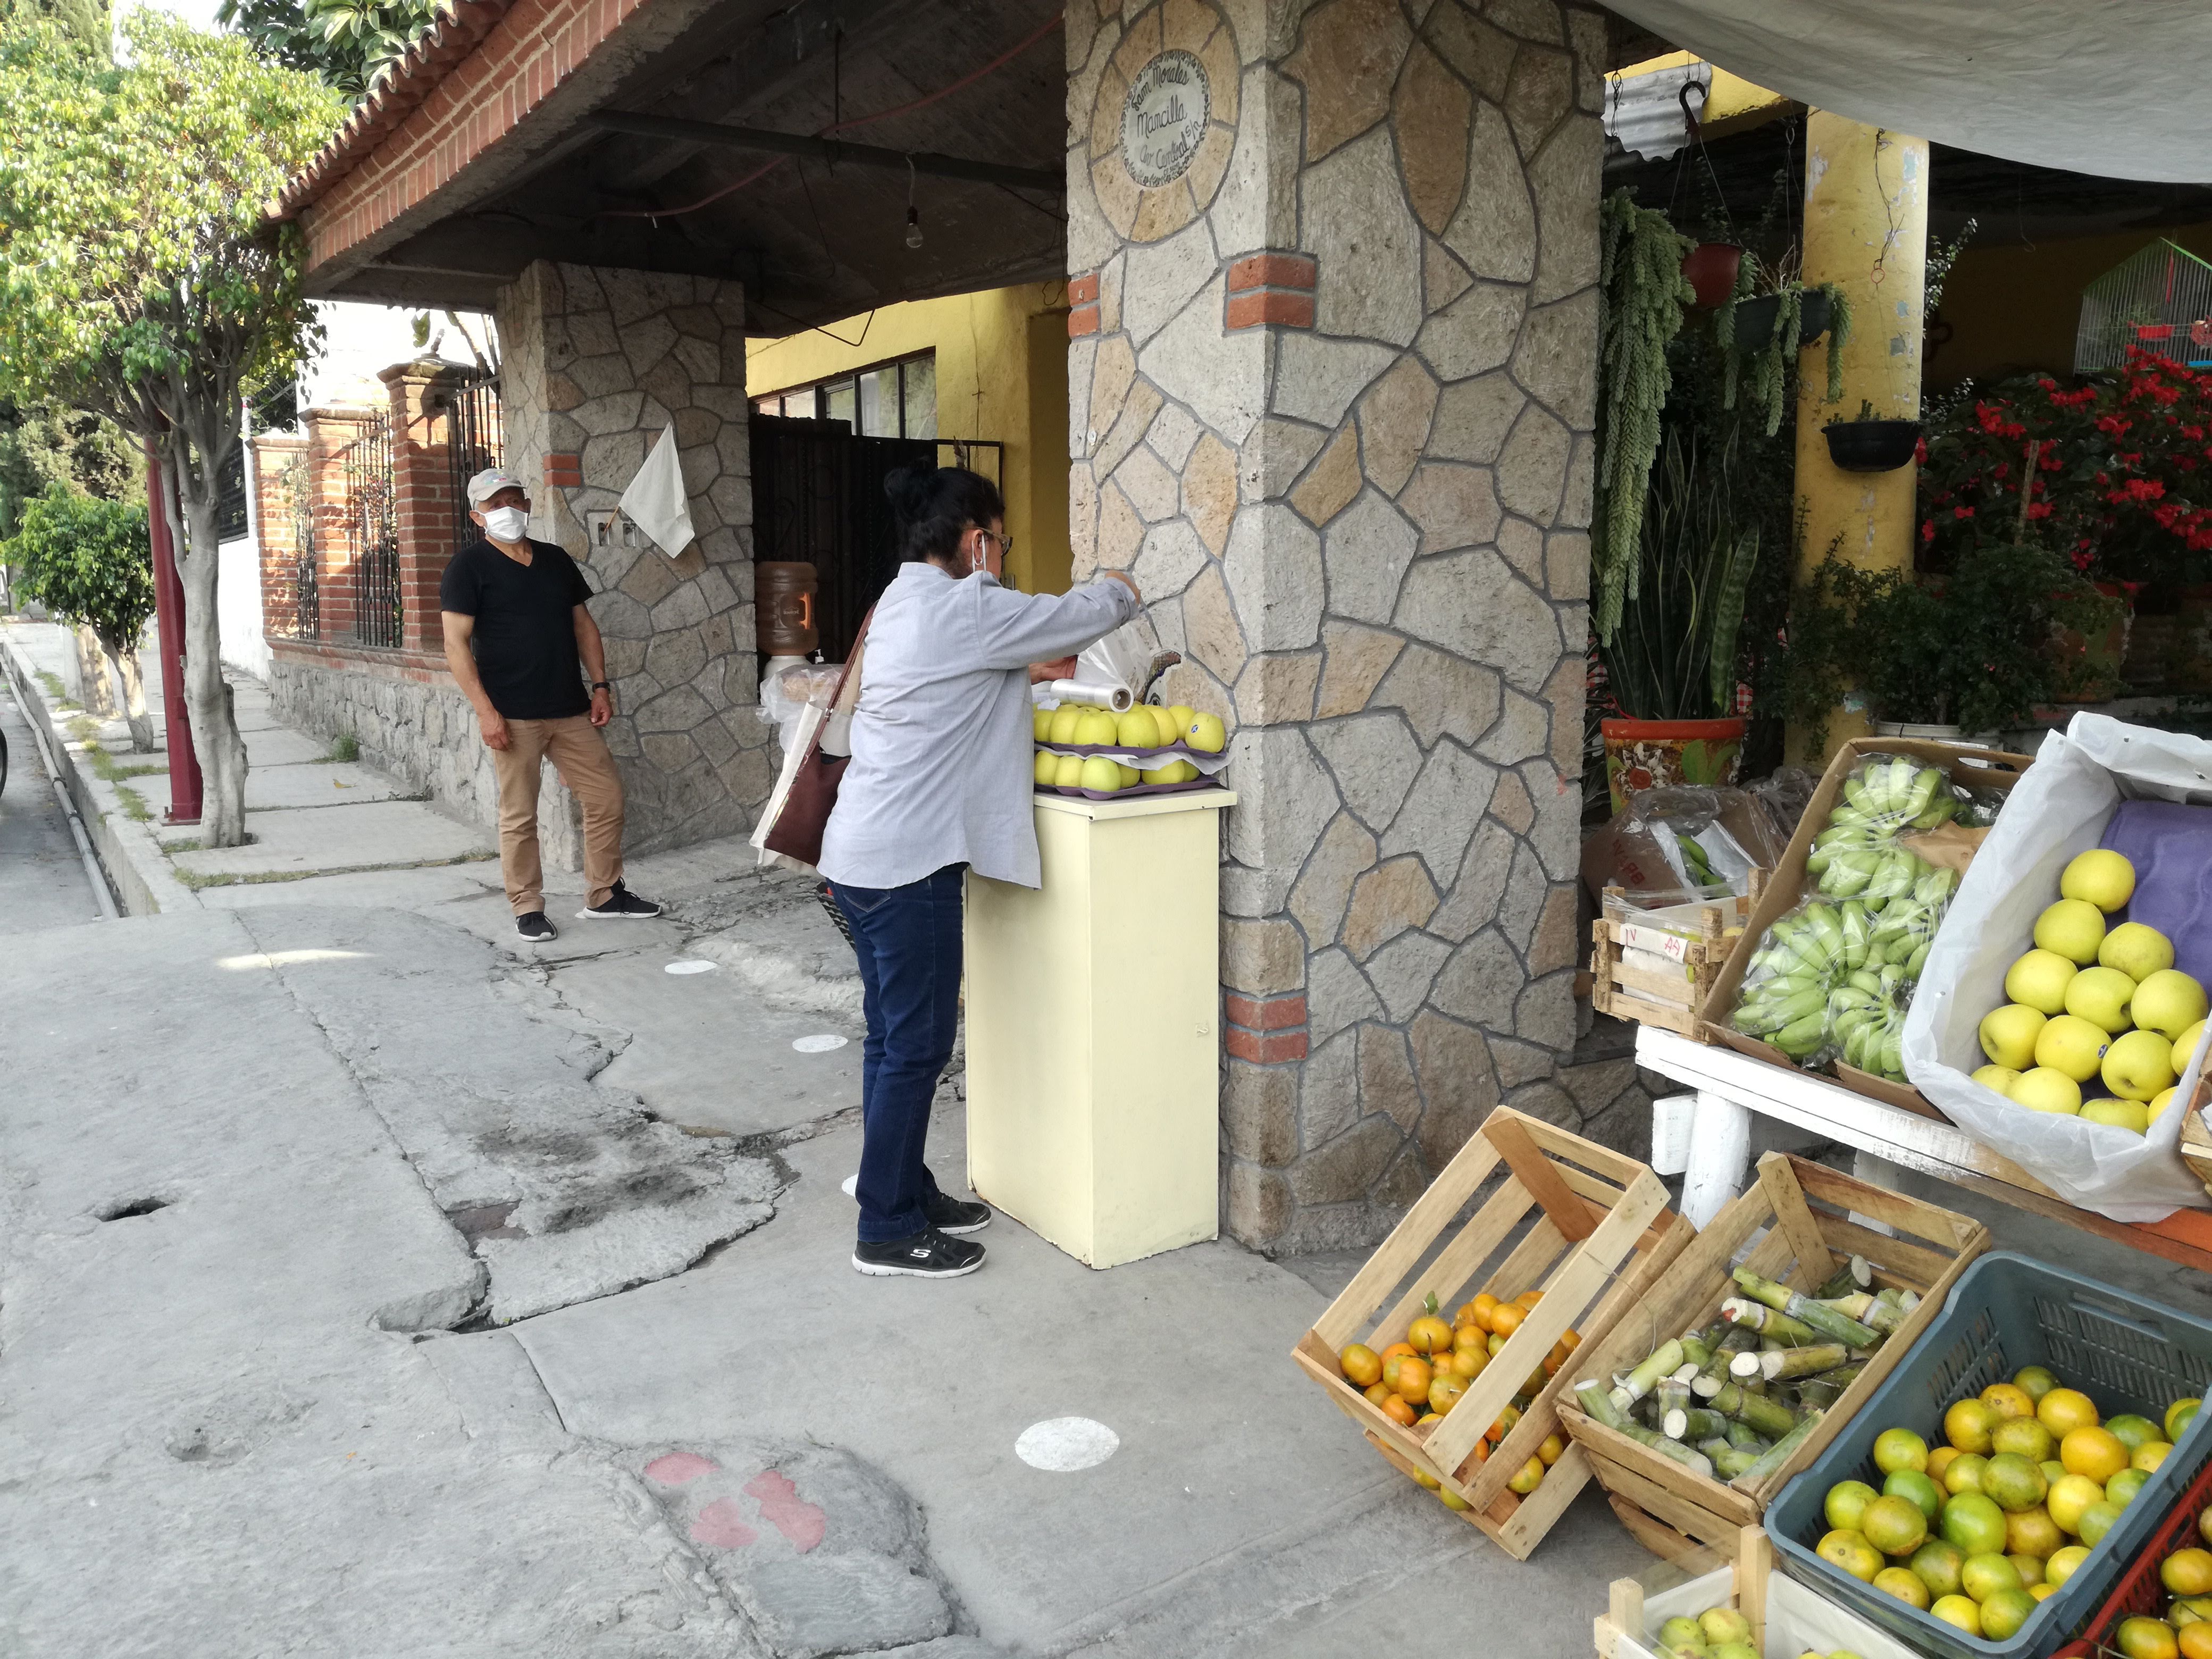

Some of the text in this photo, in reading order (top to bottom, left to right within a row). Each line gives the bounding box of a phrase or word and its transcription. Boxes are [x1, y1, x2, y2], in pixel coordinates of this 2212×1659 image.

[1152, 60, 1189, 88] Morales
[1137, 95, 1187, 139] Mancilla
[1156, 132, 1191, 169] Central
